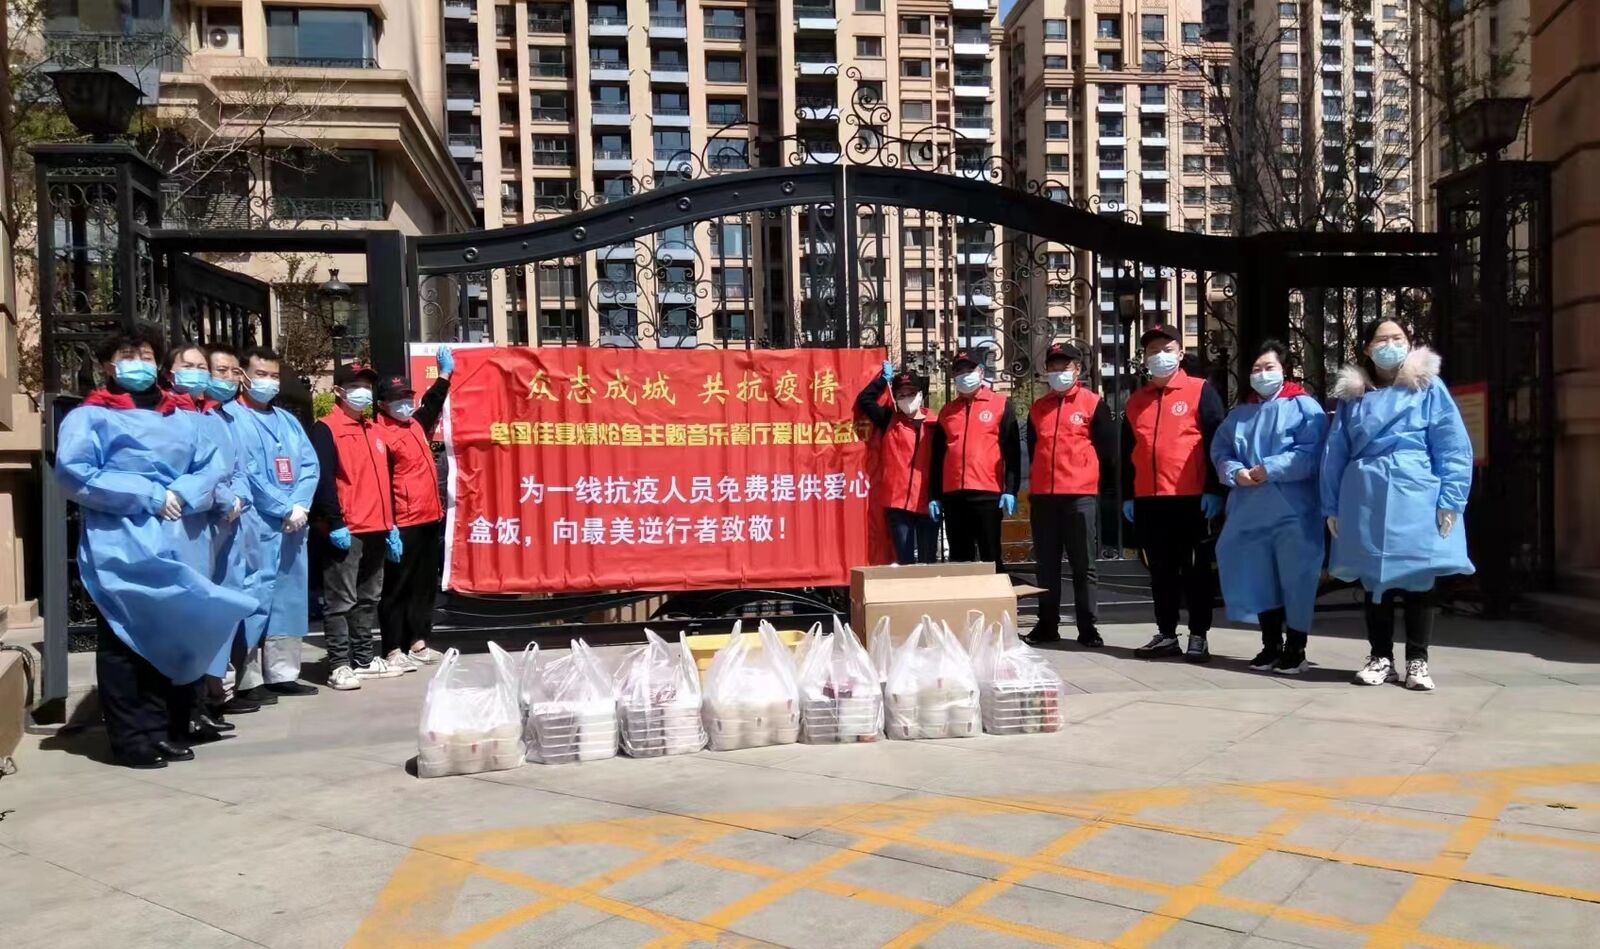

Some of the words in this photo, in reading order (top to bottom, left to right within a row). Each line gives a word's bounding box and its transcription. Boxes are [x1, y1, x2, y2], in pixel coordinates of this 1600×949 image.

[527, 365, 677, 406] 众志成城
[697, 369, 839, 405] 共抗疫情
[519, 471, 871, 504] 为一线抗疫人员免费提供爱心
